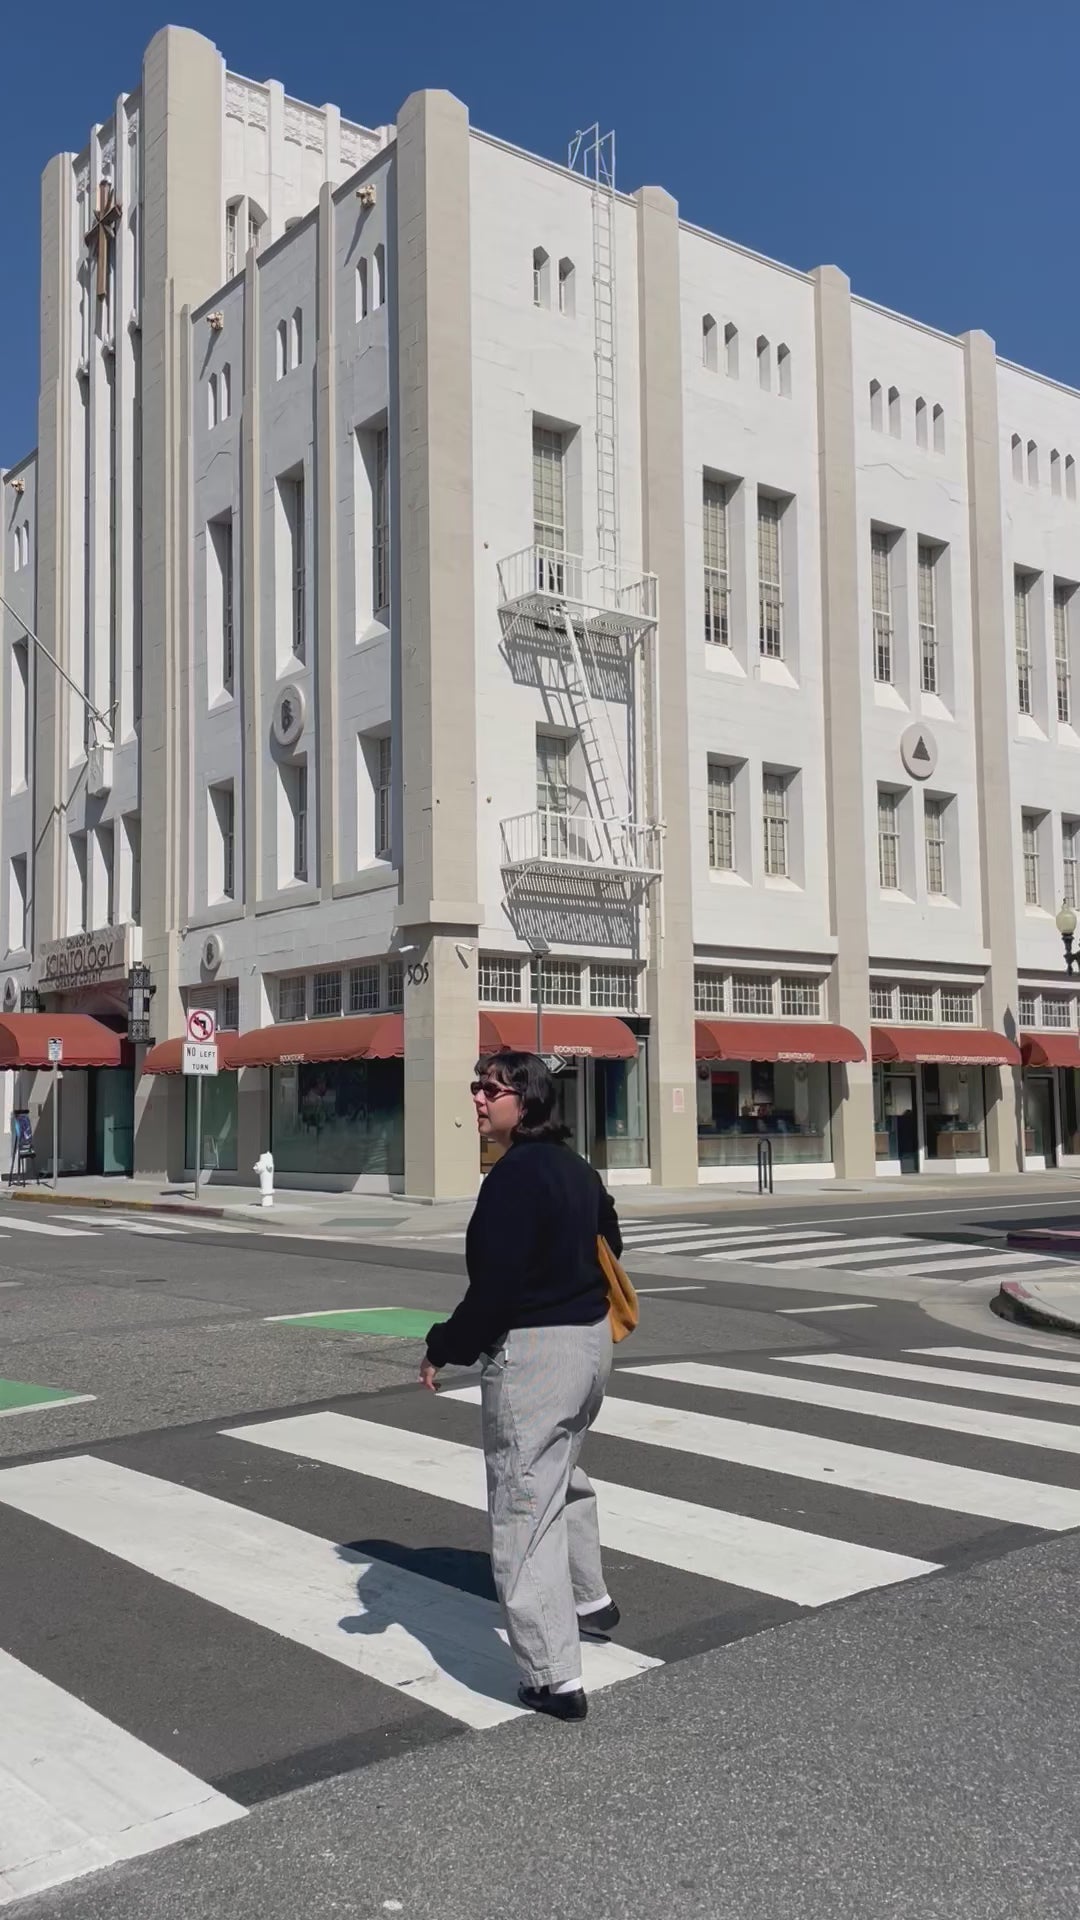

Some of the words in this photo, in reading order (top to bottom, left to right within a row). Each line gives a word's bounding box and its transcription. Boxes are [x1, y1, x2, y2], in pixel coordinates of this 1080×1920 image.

[46, 942, 113, 977] SCIENTOLOGY
[407, 962, 429, 986] 505
[186, 1046, 197, 1057] NO
[553, 1045, 593, 1054] BOOKSTORE
[192, 1063, 209, 1071] TURN
